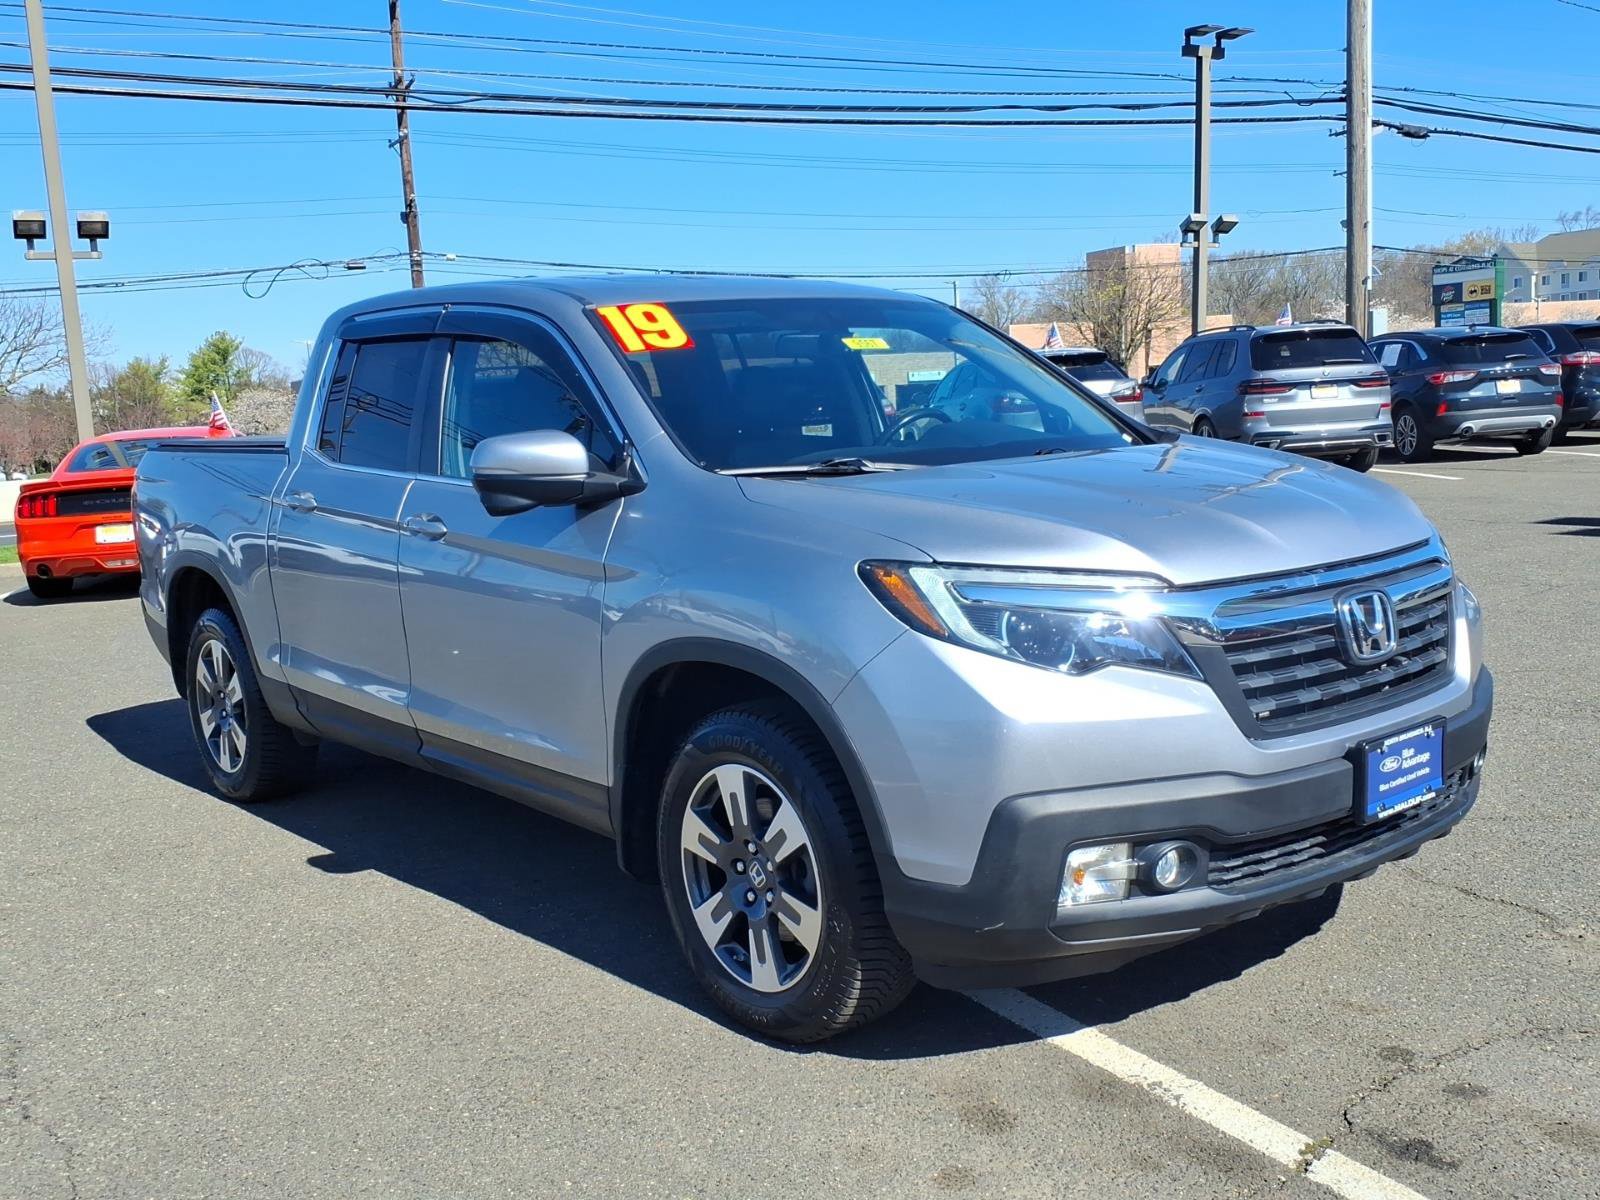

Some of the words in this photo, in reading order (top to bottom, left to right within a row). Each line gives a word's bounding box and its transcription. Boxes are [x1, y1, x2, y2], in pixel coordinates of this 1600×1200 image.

[596, 303, 688, 352] 19
[1402, 748, 1415, 758] Blue
[1402, 752, 1430, 769] Advantage
[1382, 757, 1398, 770] Ford
